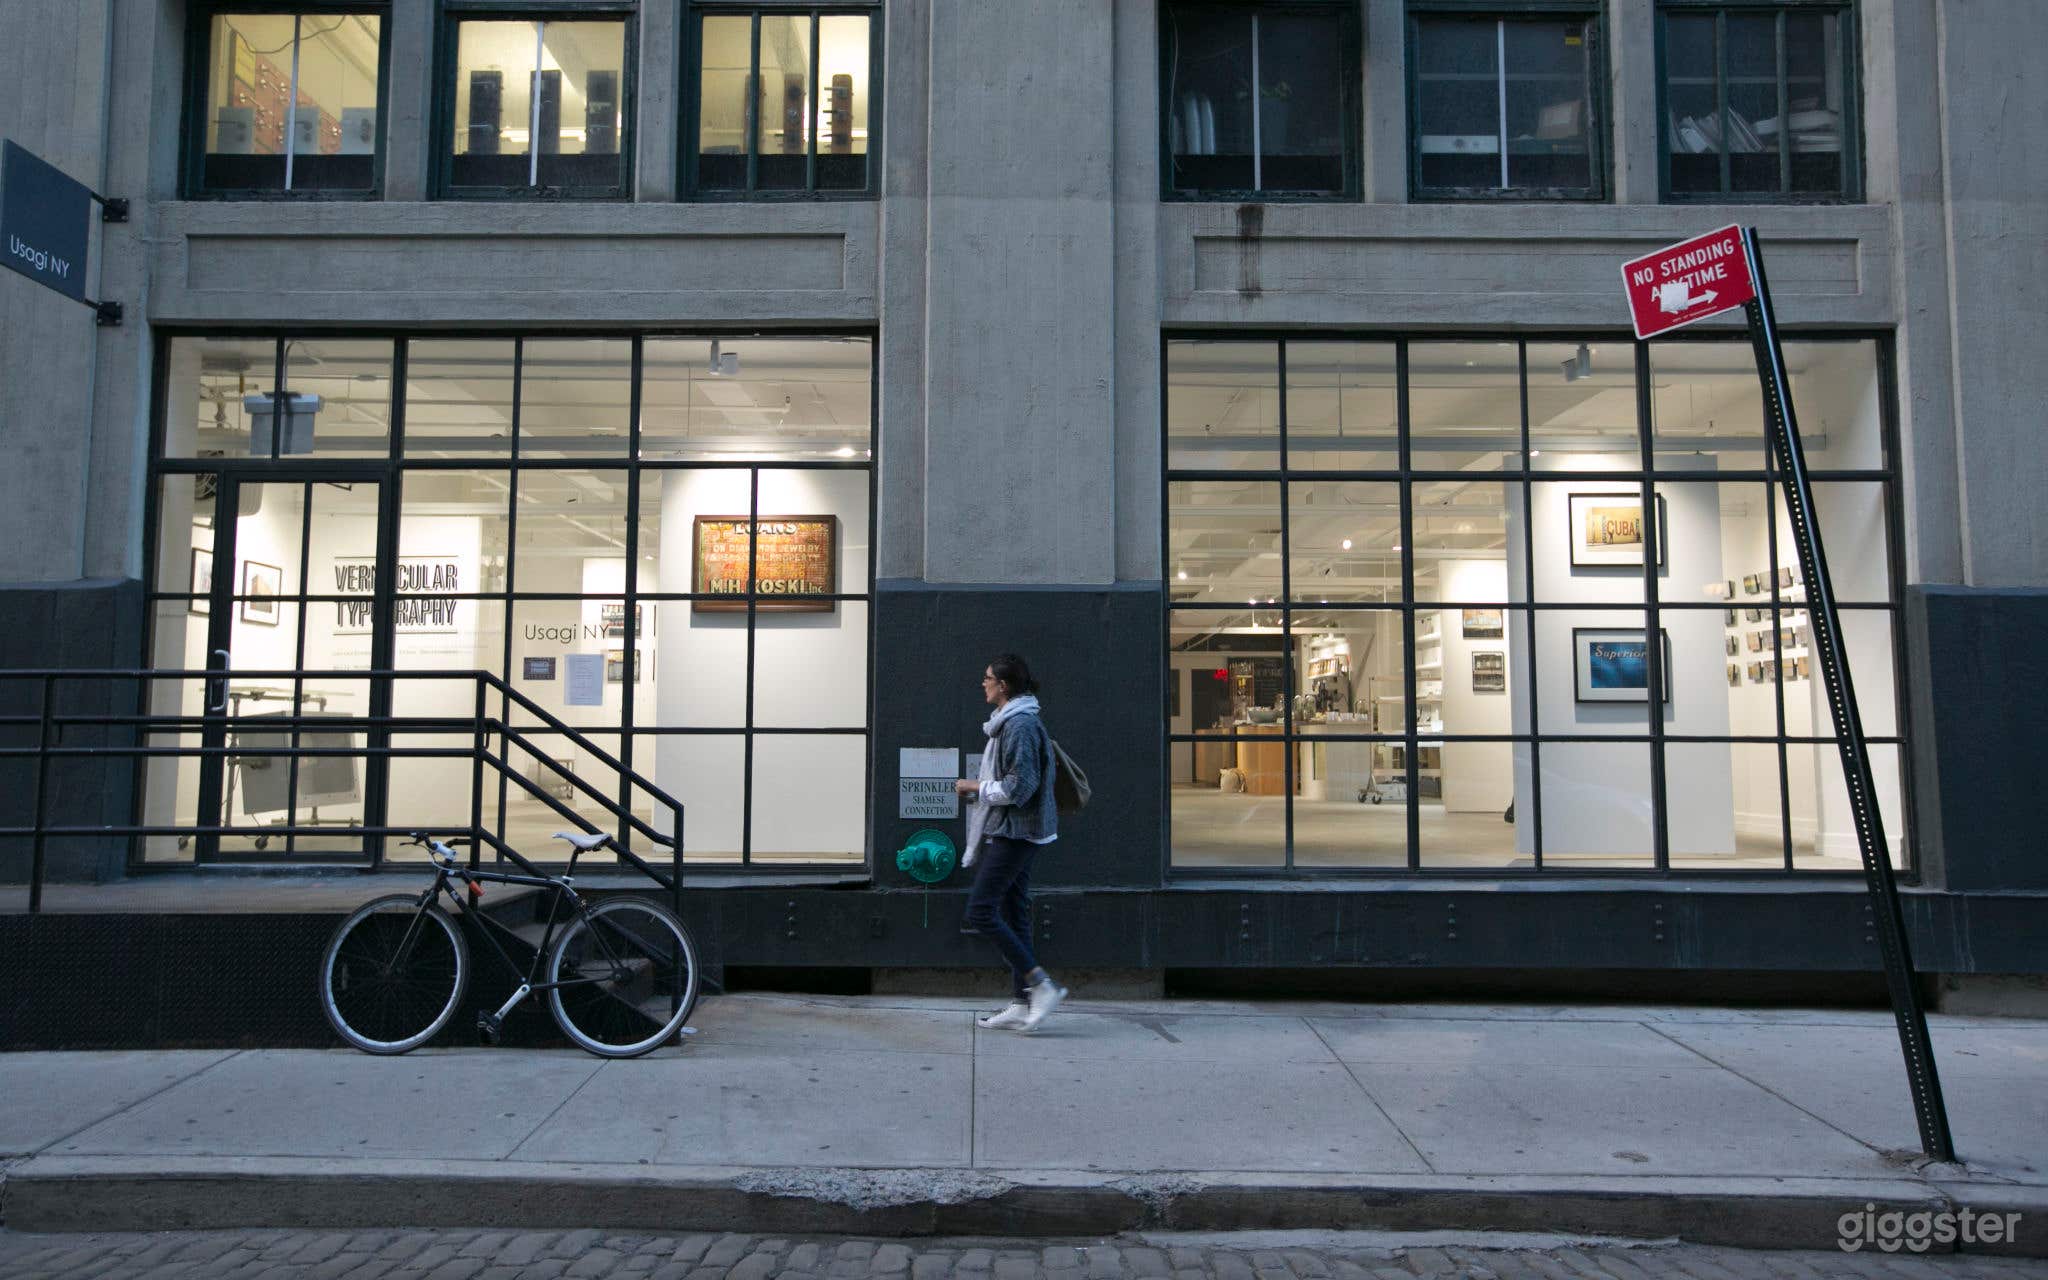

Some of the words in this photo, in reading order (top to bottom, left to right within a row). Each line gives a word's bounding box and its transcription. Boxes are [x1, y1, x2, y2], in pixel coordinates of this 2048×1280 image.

[10, 234, 48, 271] Usagi
[51, 256, 70, 278] NY
[1633, 267, 1654, 286] NO
[1660, 239, 1734, 277] STANDING
[1651, 263, 1728, 302] ATIME
[1607, 520, 1636, 536] CUBA
[335, 564, 458, 592] VERCULAR
[337, 599, 458, 627] TYPRAPHY
[525, 624, 577, 644] Usagi
[584, 624, 610, 640] NY
[1595, 645, 1647, 660] Superior
[902, 781, 957, 793] SPRINKLER
[912, 795, 945, 804] SIAMESE
[905, 806, 952, 815] CONNECTION
